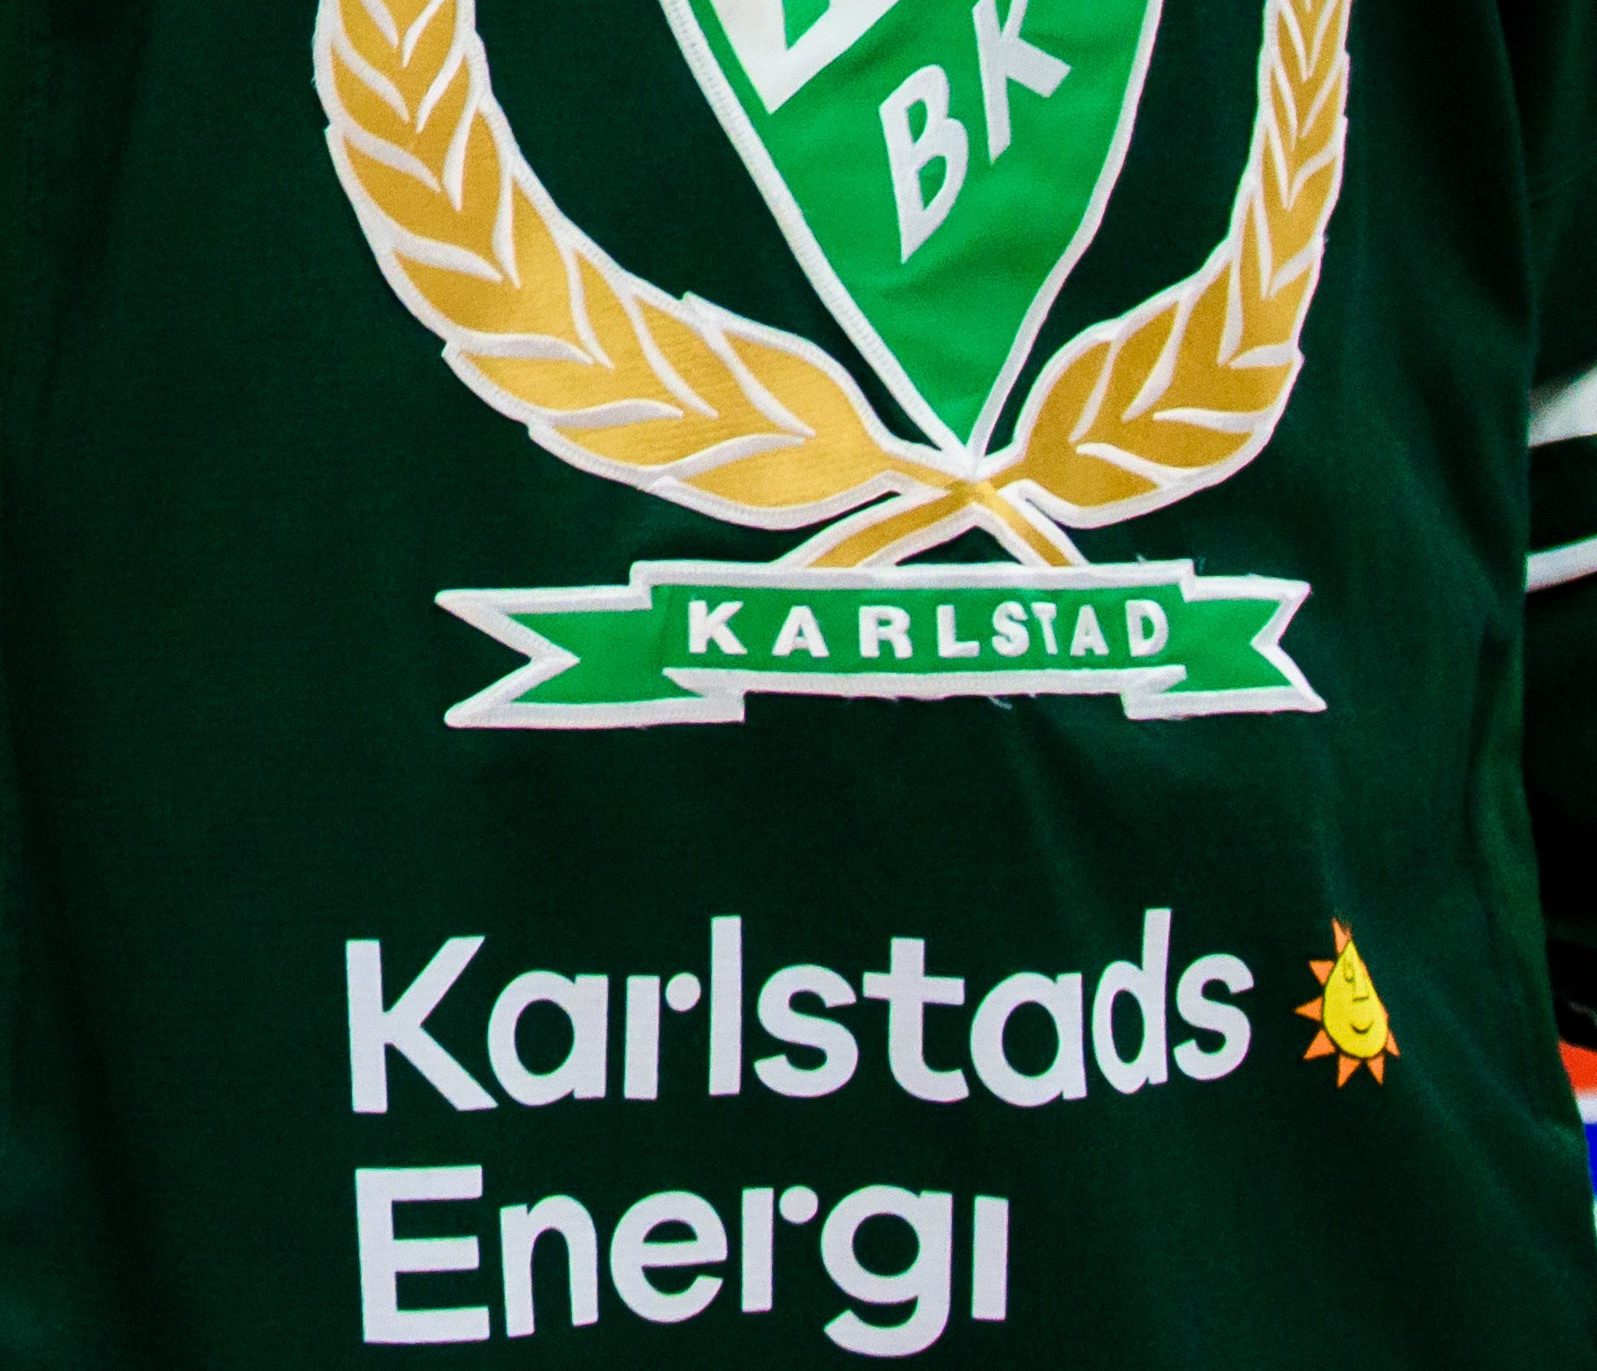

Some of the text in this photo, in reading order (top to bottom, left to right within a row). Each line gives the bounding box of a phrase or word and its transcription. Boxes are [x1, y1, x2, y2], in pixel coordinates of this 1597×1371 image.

[687, 599, 1170, 660] KARLSTAD
[344, 905, 1256, 1114] Karlstads
[354, 1162, 1010, 1357] Energi
